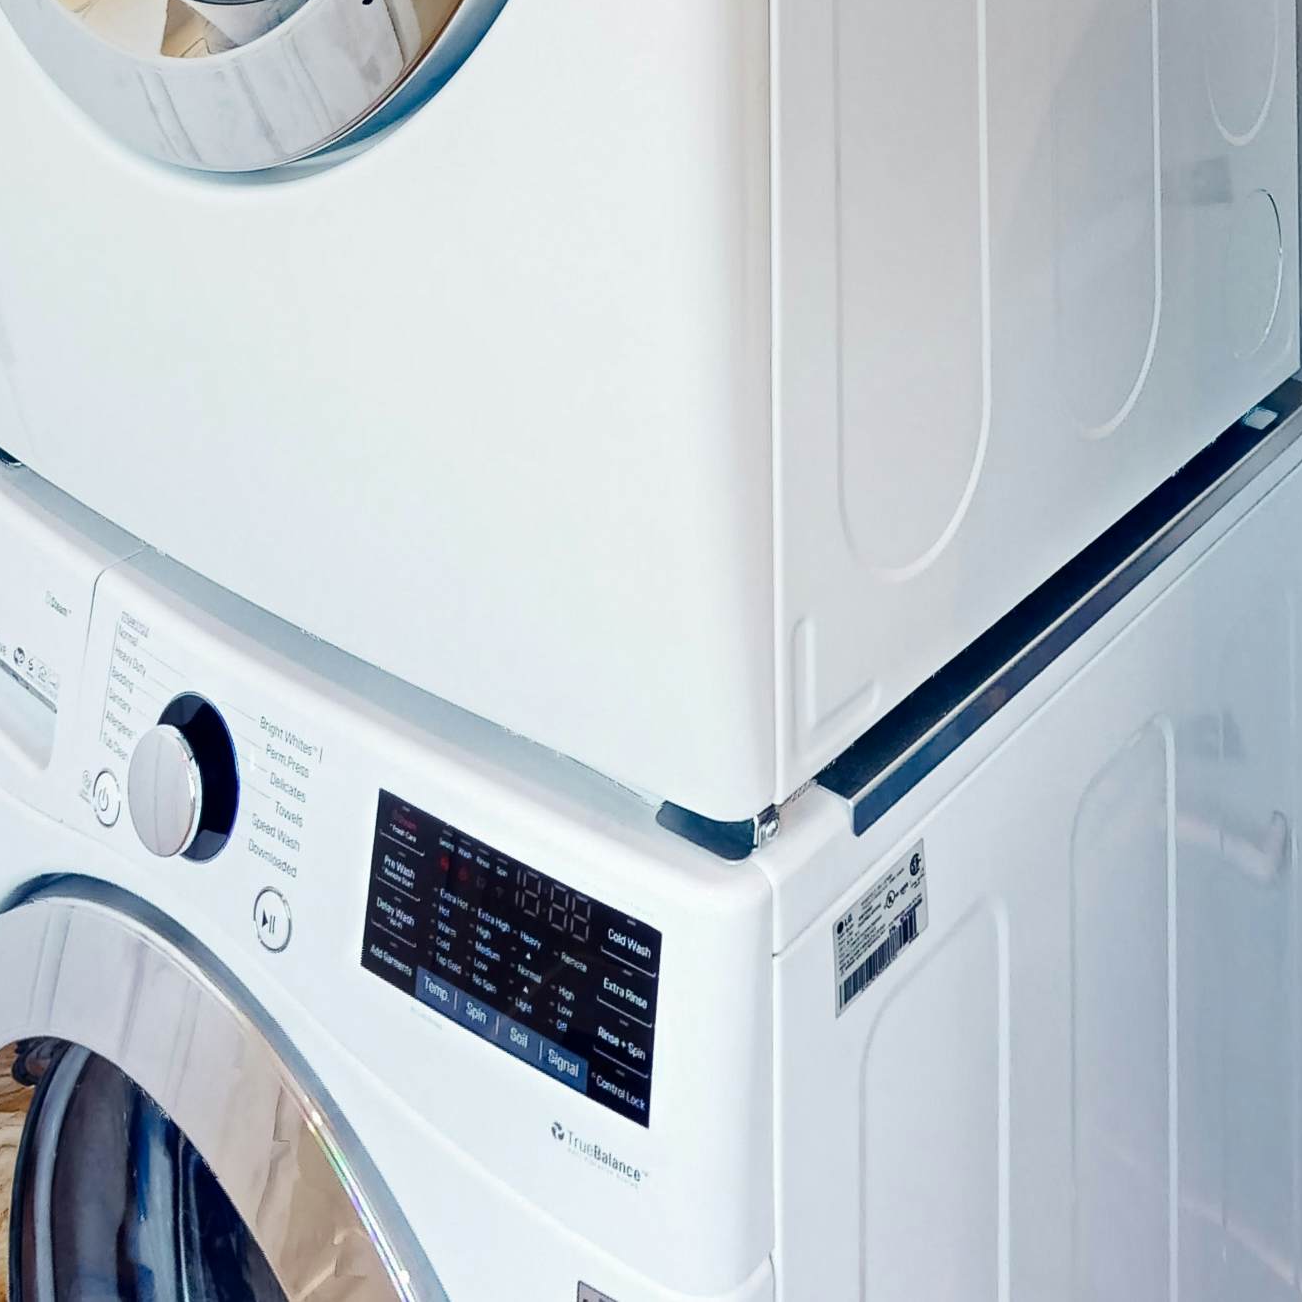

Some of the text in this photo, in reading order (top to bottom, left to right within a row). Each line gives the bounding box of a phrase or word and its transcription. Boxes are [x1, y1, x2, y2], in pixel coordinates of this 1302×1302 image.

[259, 715, 283, 741] Bright
[269, 771, 307, 803] Delicates
[275, 800, 304, 828] Towels
[251, 812, 301, 854] Speed Wash
[248, 838, 298, 879] Downloaded
[383, 854, 416, 880] Pre Wash
[376, 896, 416, 928] Delay Wash
[457, 898, 469, 912] Hot
[476, 923, 492, 940] High
[477, 906, 511, 934] Extra High
[435, 935, 451, 952] Cold
[475, 940, 501, 962] Medium
[520, 929, 542, 951] Heavy
[608, 927, 652, 960] Cold Wash
[474, 957, 489, 972] Low
[517, 962, 543, 985] Normal
[424, 974, 451, 1004] Temp.
[558, 984, 576, 1003] High
[603, 976, 648, 1011] Extra Rinse
[465, 999, 488, 1026] Spin
[557, 1002, 574, 1019] Low
[509, 1026, 529, 1050] Soil
[597, 1024, 620, 1048] Rinse
[627, 1041, 647, 1062] Spin
[548, 1047, 580, 1079] Signal
[596, 1074, 647, 1111] Control Lock
